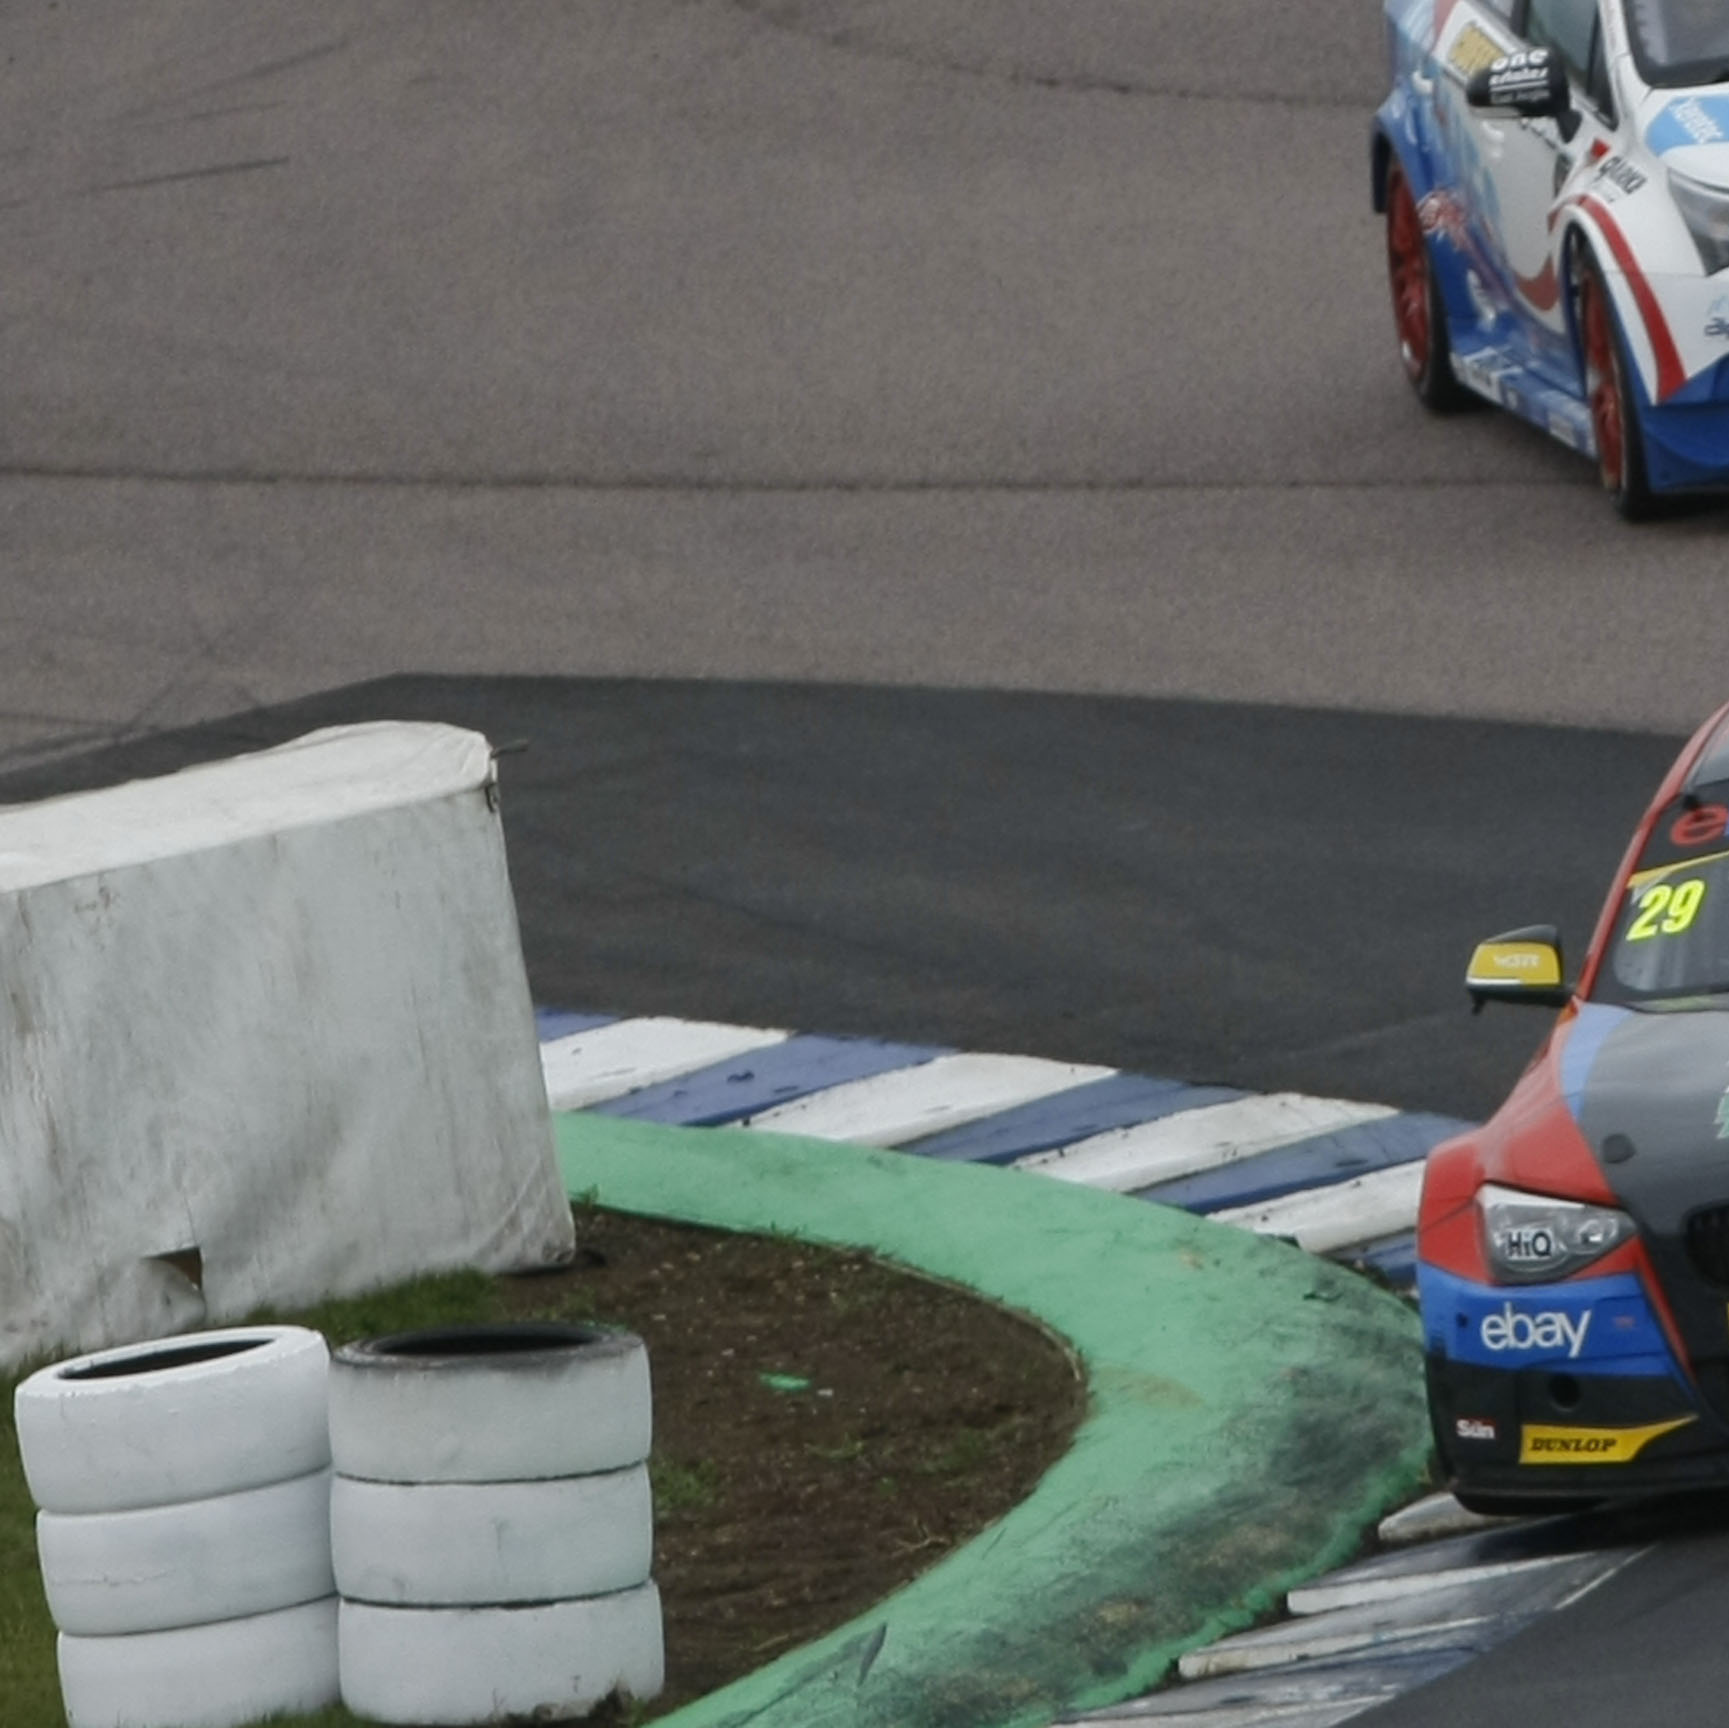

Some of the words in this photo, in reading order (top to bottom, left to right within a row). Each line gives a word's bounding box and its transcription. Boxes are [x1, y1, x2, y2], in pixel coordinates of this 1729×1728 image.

[1625, 879, 1705, 942] 29
[1507, 1229, 1553, 1258] HiQ
[1480, 1301, 1591, 1358] ebay
[1529, 1436, 1618, 1456] DUNLOP
